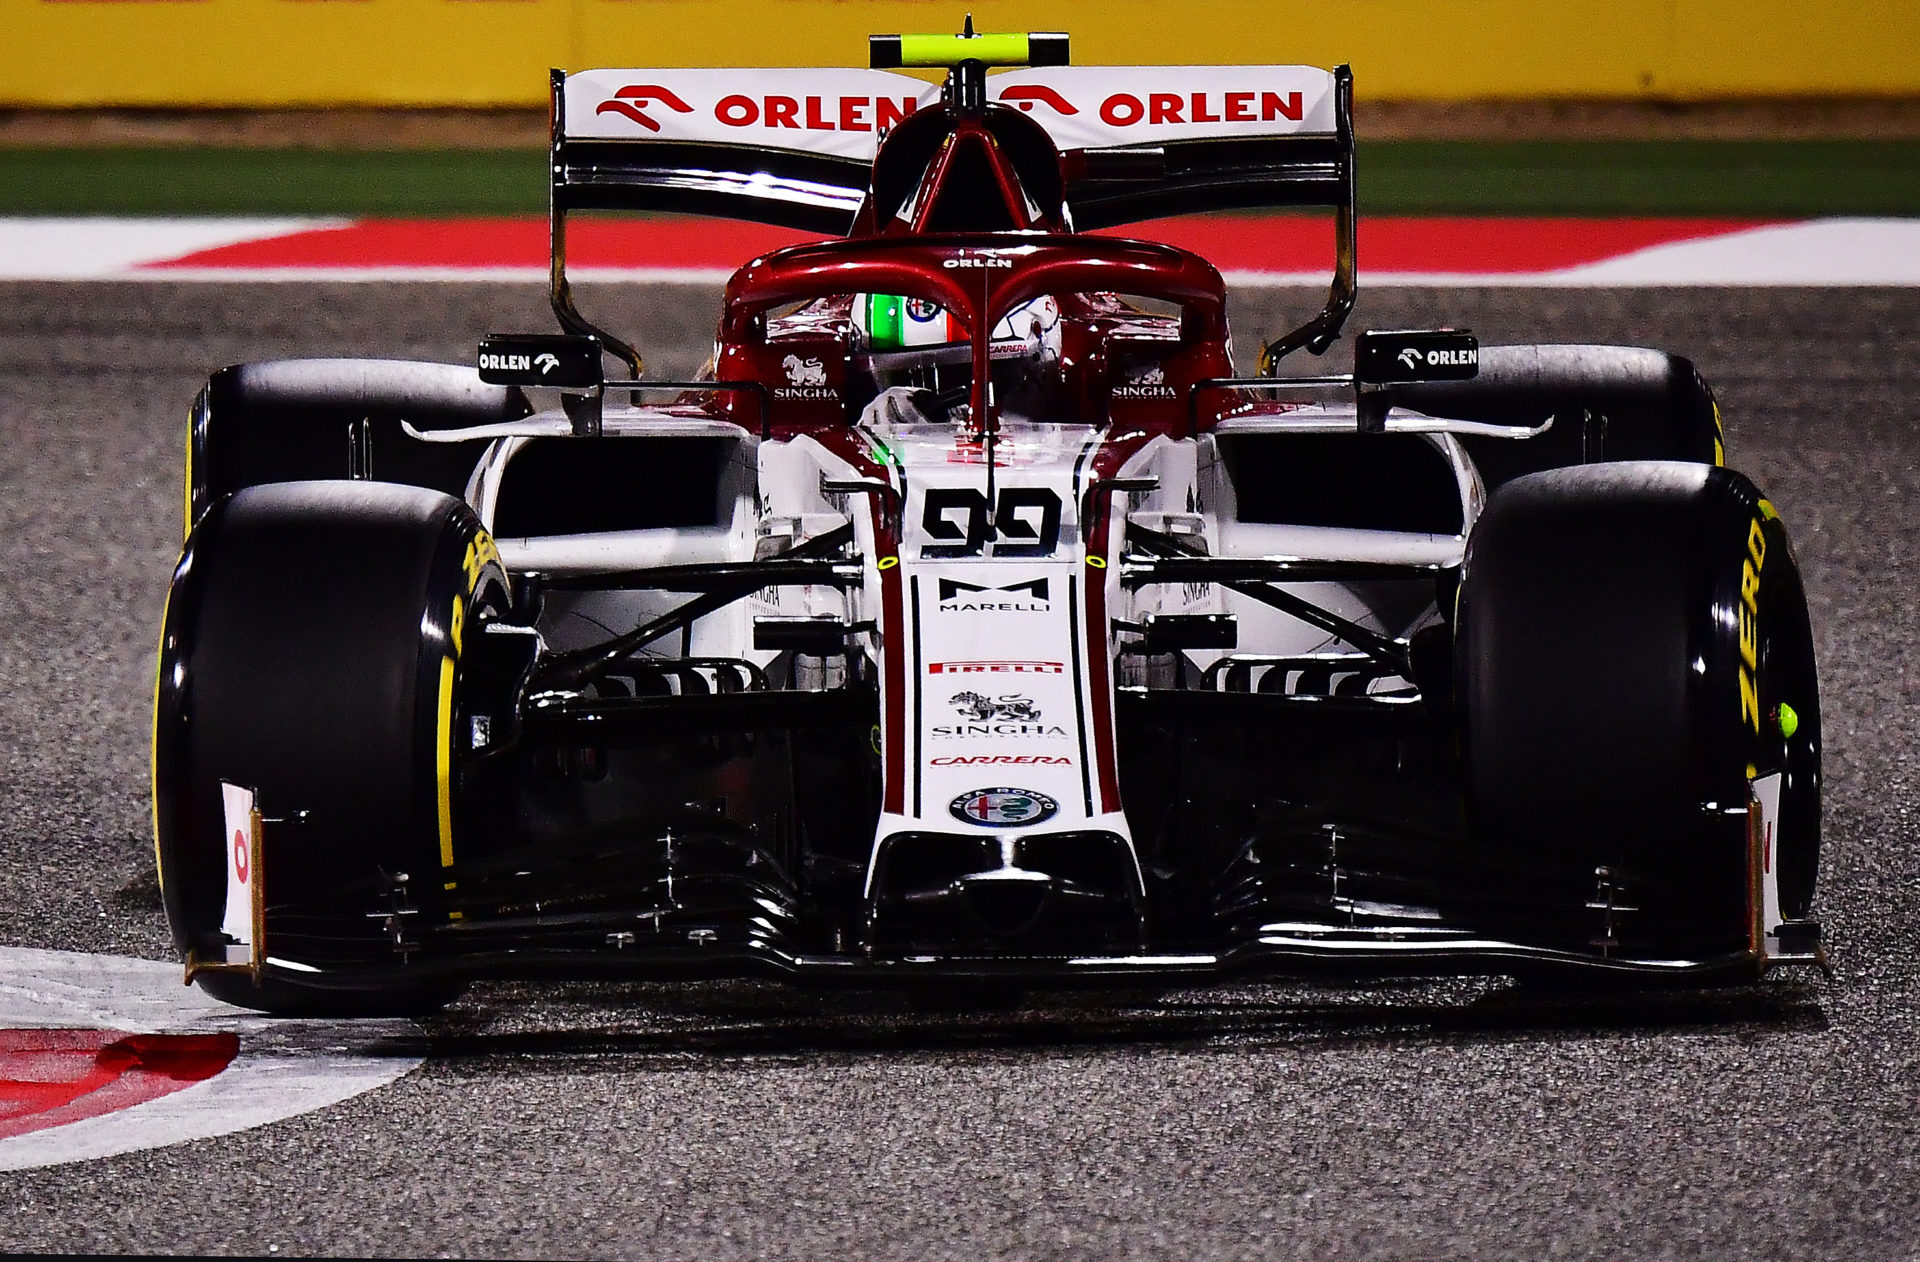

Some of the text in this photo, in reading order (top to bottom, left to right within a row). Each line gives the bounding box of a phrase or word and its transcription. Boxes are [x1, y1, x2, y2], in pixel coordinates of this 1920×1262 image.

[714, 94, 917, 131] ORLEN
[1099, 92, 1303, 127] ORLEN
[943, 259, 1012, 268] ORLEN
[479, 354, 530, 370] ORLEN
[1427, 350, 1477, 365] ORLEN
[774, 388, 838, 398] SINGHA
[1112, 387, 1176, 396] SINGHA
[920, 488, 1062, 559] 99
[940, 603, 1050, 612] MARELLI
[1738, 517, 1766, 736] ZERO
[929, 661, 1064, 674] PIRELLI
[932, 725, 1068, 737] SINGHA
[930, 756, 1072, 766] CARRERA
[952, 789, 1055, 809] ALFA ROMEO
